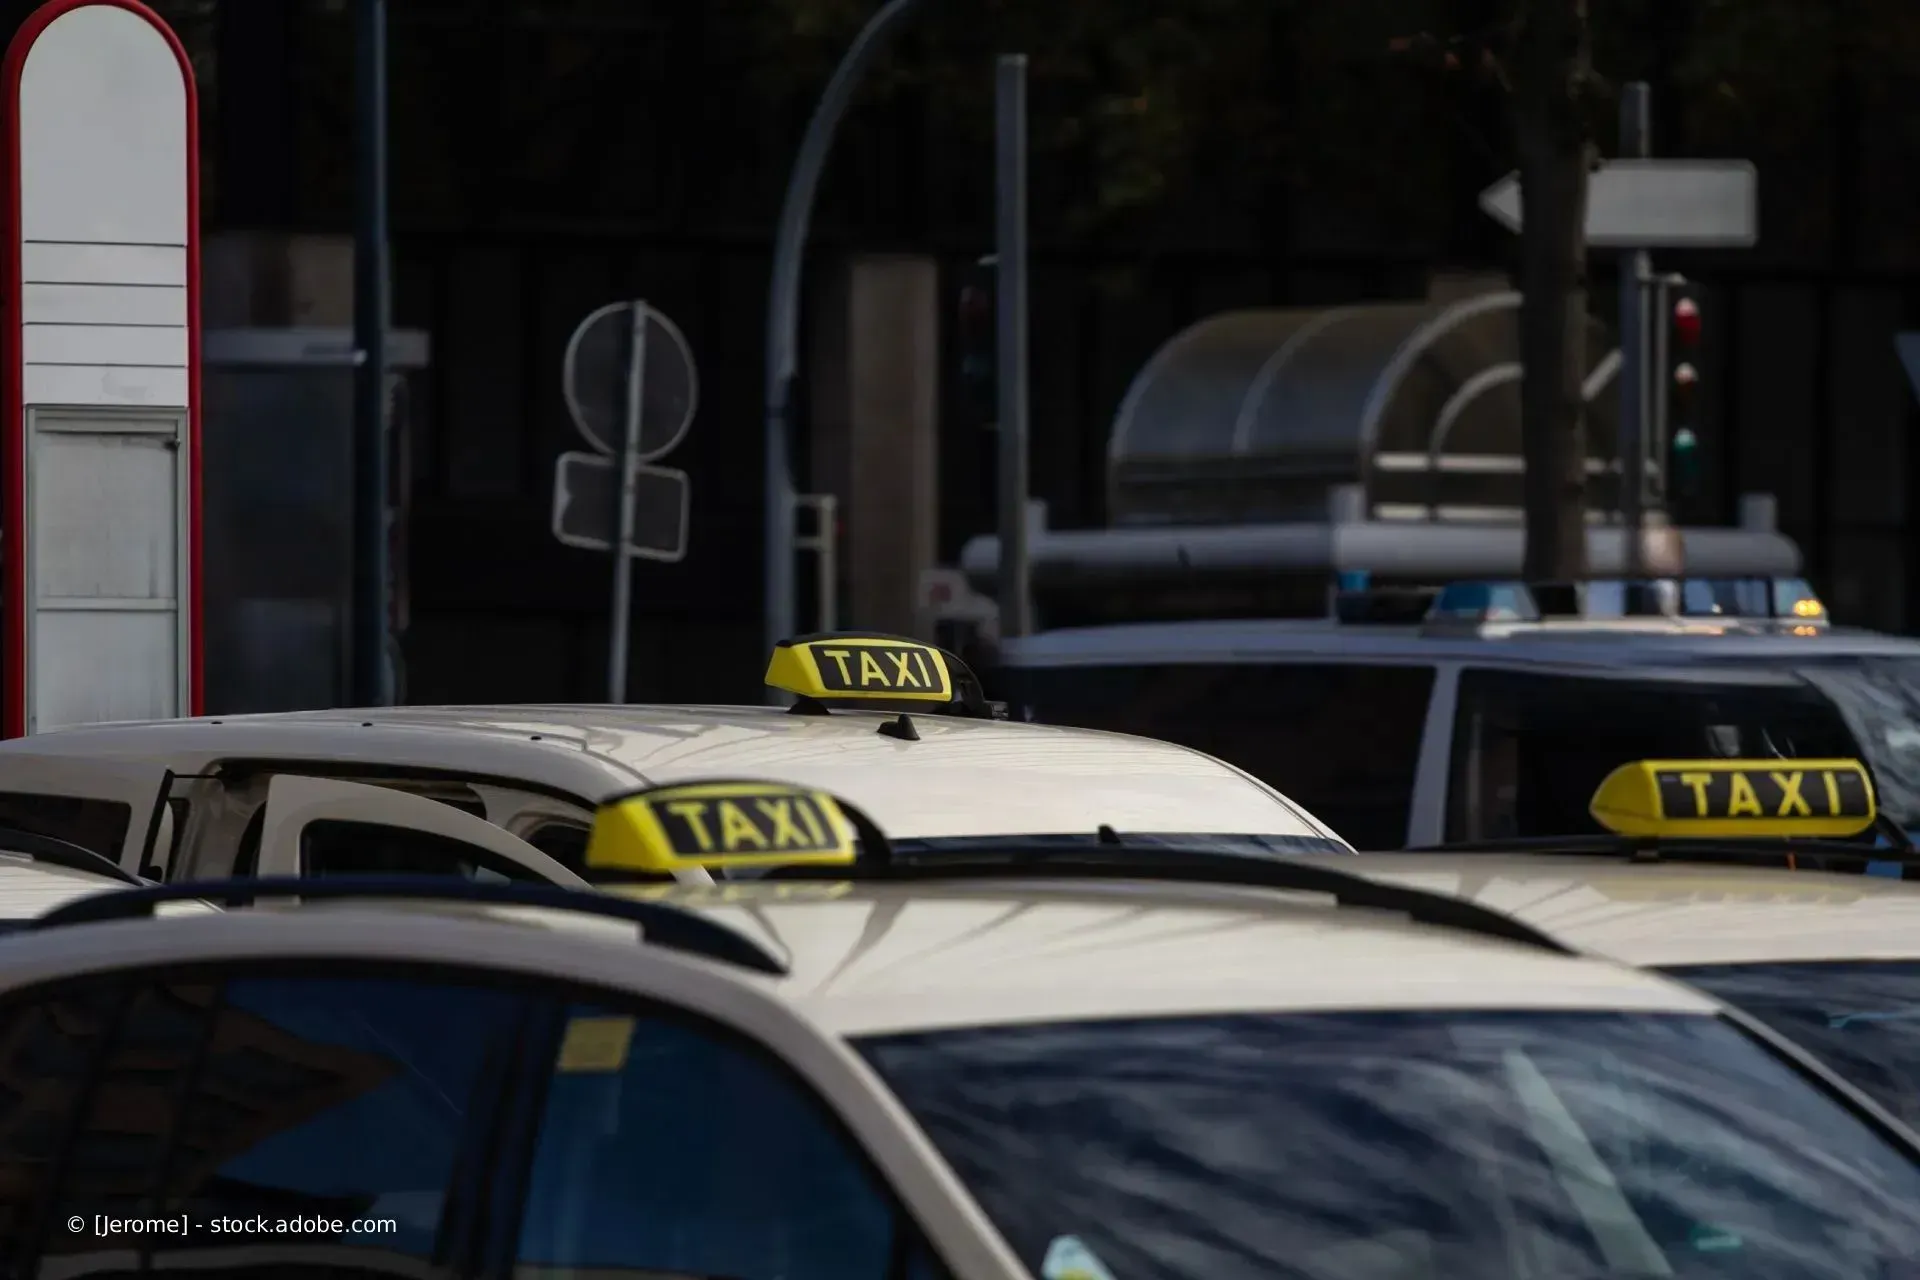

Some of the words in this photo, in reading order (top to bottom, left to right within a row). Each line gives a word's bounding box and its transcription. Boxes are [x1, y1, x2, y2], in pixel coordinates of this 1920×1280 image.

[823, 649, 932, 688] TAXI
[1680, 771, 1841, 817] TAXI
[667, 793, 828, 852] TAXI
